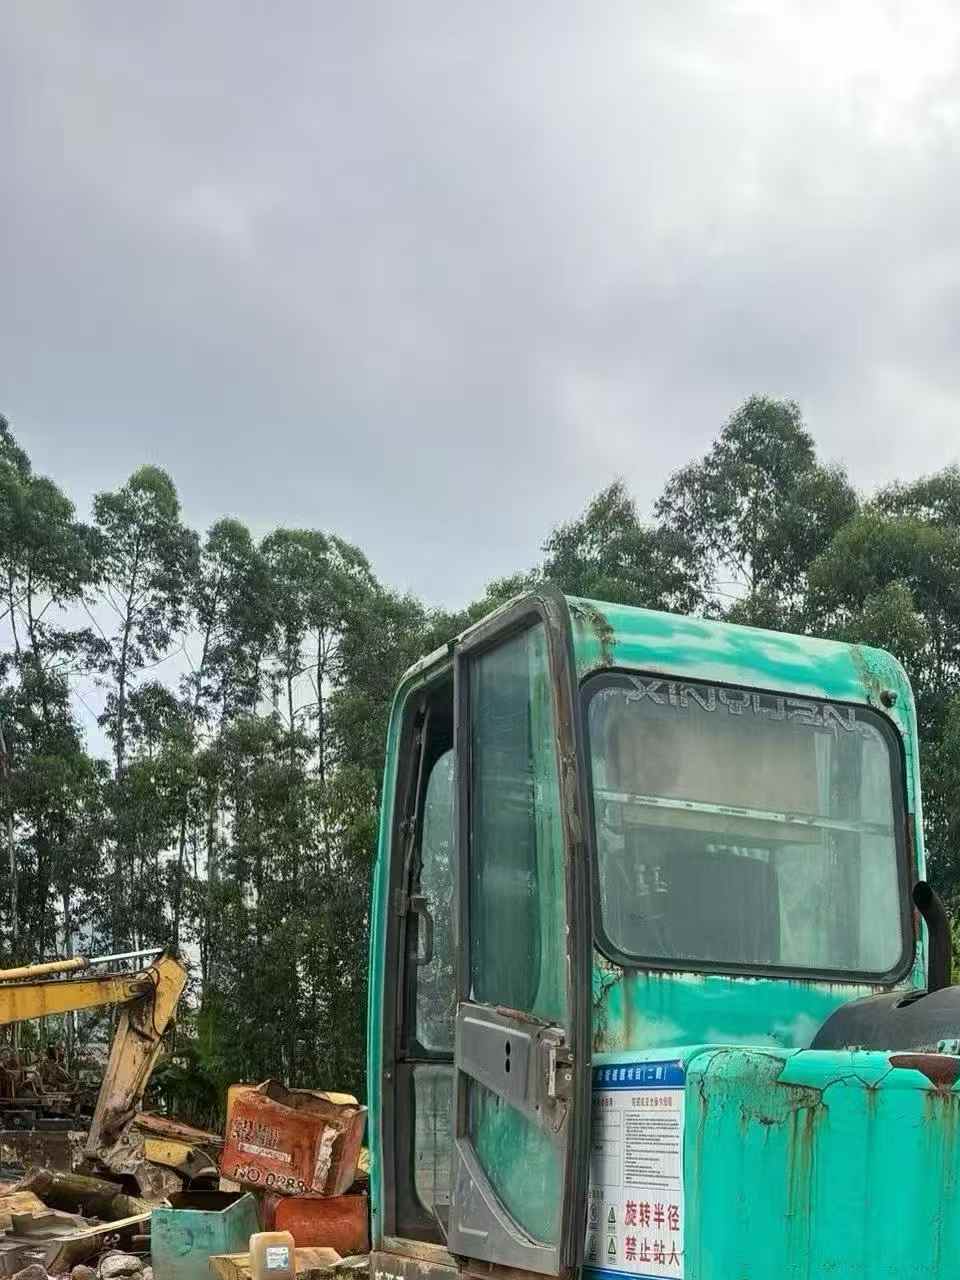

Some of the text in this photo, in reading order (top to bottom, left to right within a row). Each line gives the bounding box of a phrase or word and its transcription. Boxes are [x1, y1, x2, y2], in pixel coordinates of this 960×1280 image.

[624, 1200, 680, 1231] 旋转半径
[624, 1235, 680, 1267] 禁止站人
